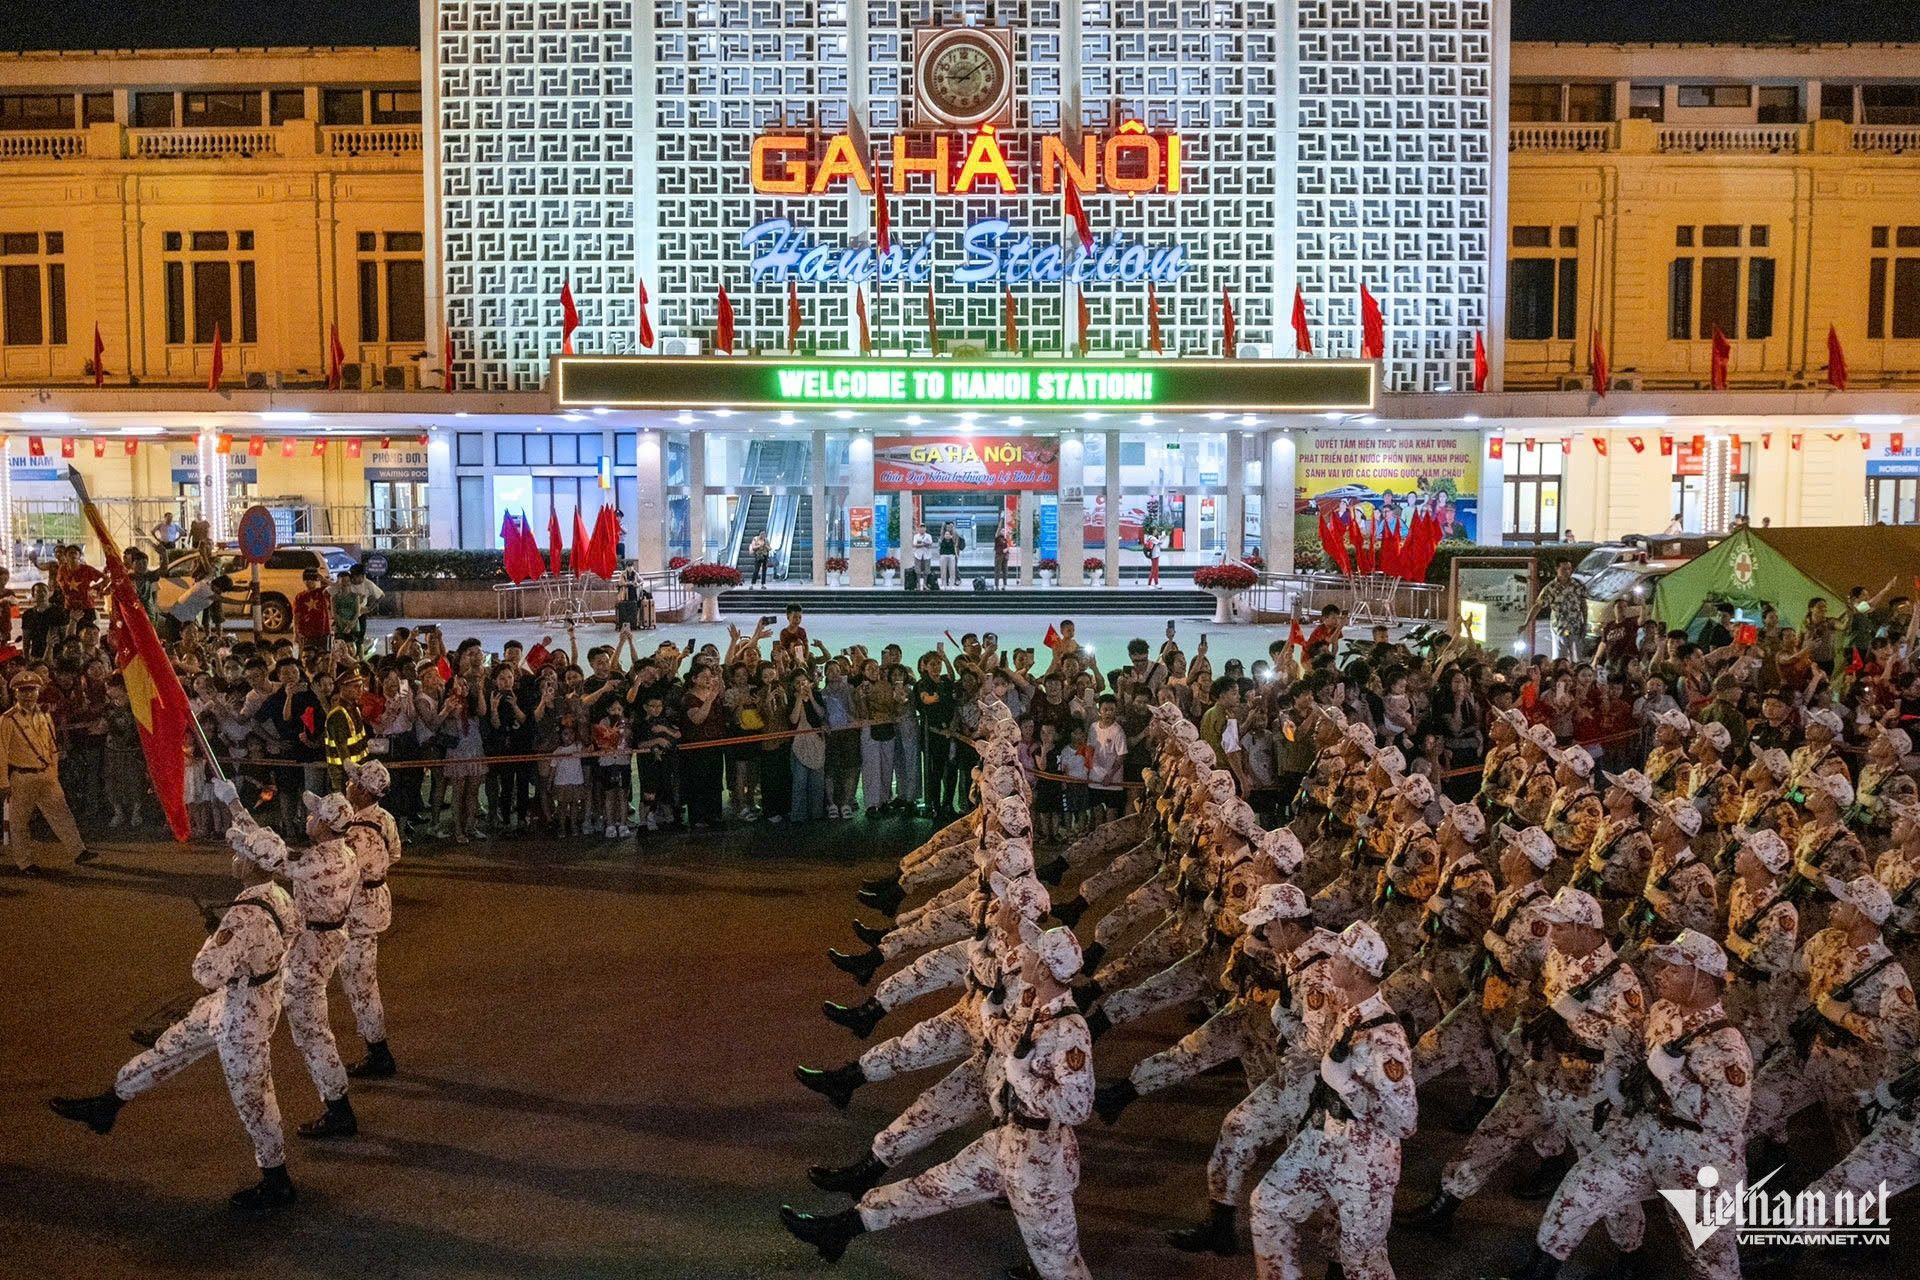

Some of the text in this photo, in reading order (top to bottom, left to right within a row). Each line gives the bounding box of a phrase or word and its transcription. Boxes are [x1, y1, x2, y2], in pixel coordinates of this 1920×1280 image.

[959, 51, 968, 59] 12
[751, 119, 1180, 199] GA HÀ NỘI
[741, 218, 1190, 284] Hanoi Station
[778, 370, 1153, 400] WELCOME TO HANOI STATION!
[181, 454, 198, 465] PHÒ
[372, 452, 403, 463] PHÒNG
[910, 442, 1022, 466] GA HÀ NỘI
[30, 456, 54, 466] NAM
[1036, 470, 1053, 483] An
[1328, 468, 1340, 478] VAI
[205, 475, 213, 487] 6
